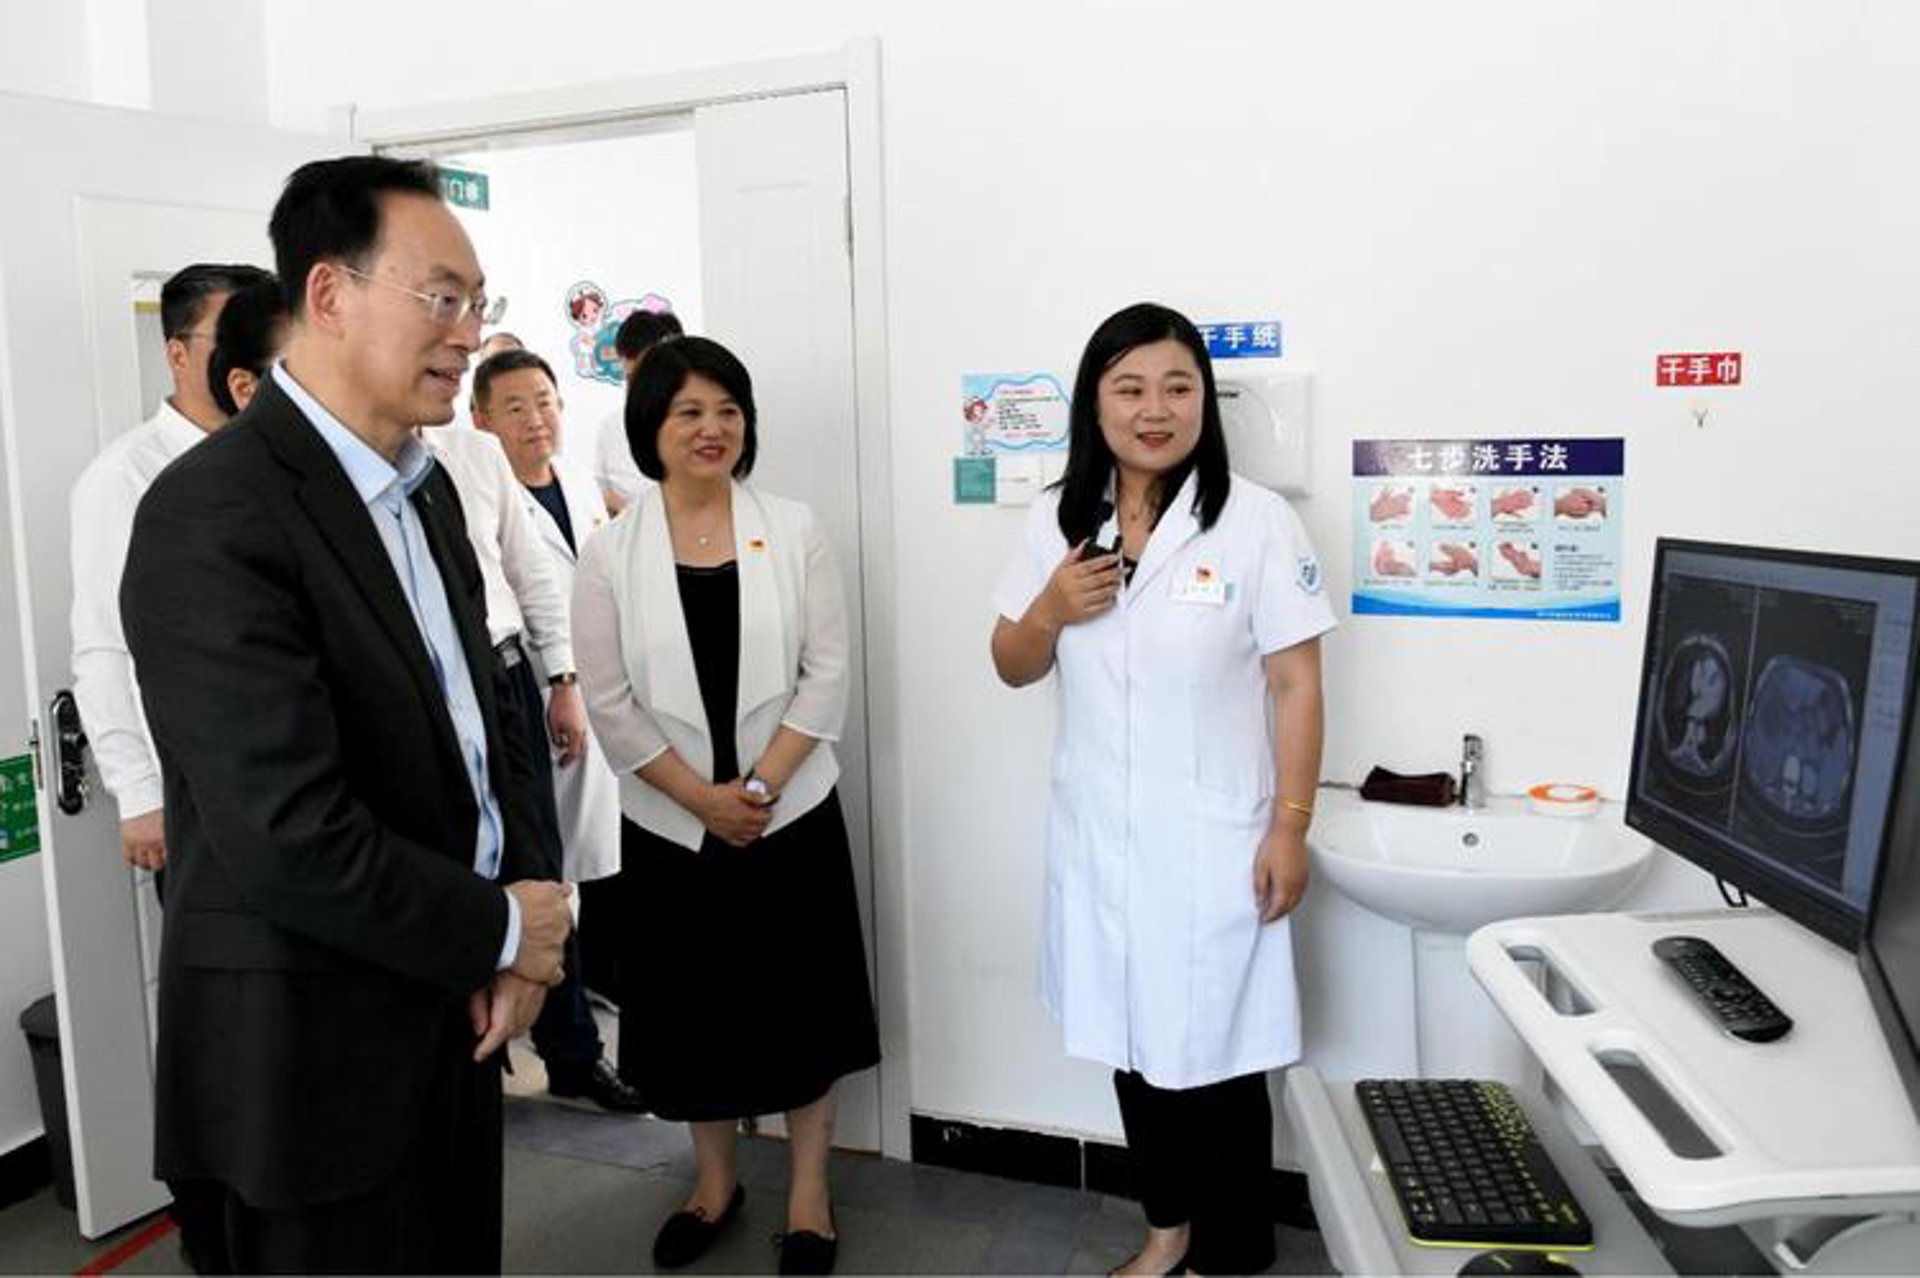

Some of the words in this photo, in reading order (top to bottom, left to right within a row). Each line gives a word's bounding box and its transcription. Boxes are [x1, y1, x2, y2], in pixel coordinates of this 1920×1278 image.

[1660, 356, 1738, 384] 干手巾
[1406, 443, 1567, 471] 七步洗手法
